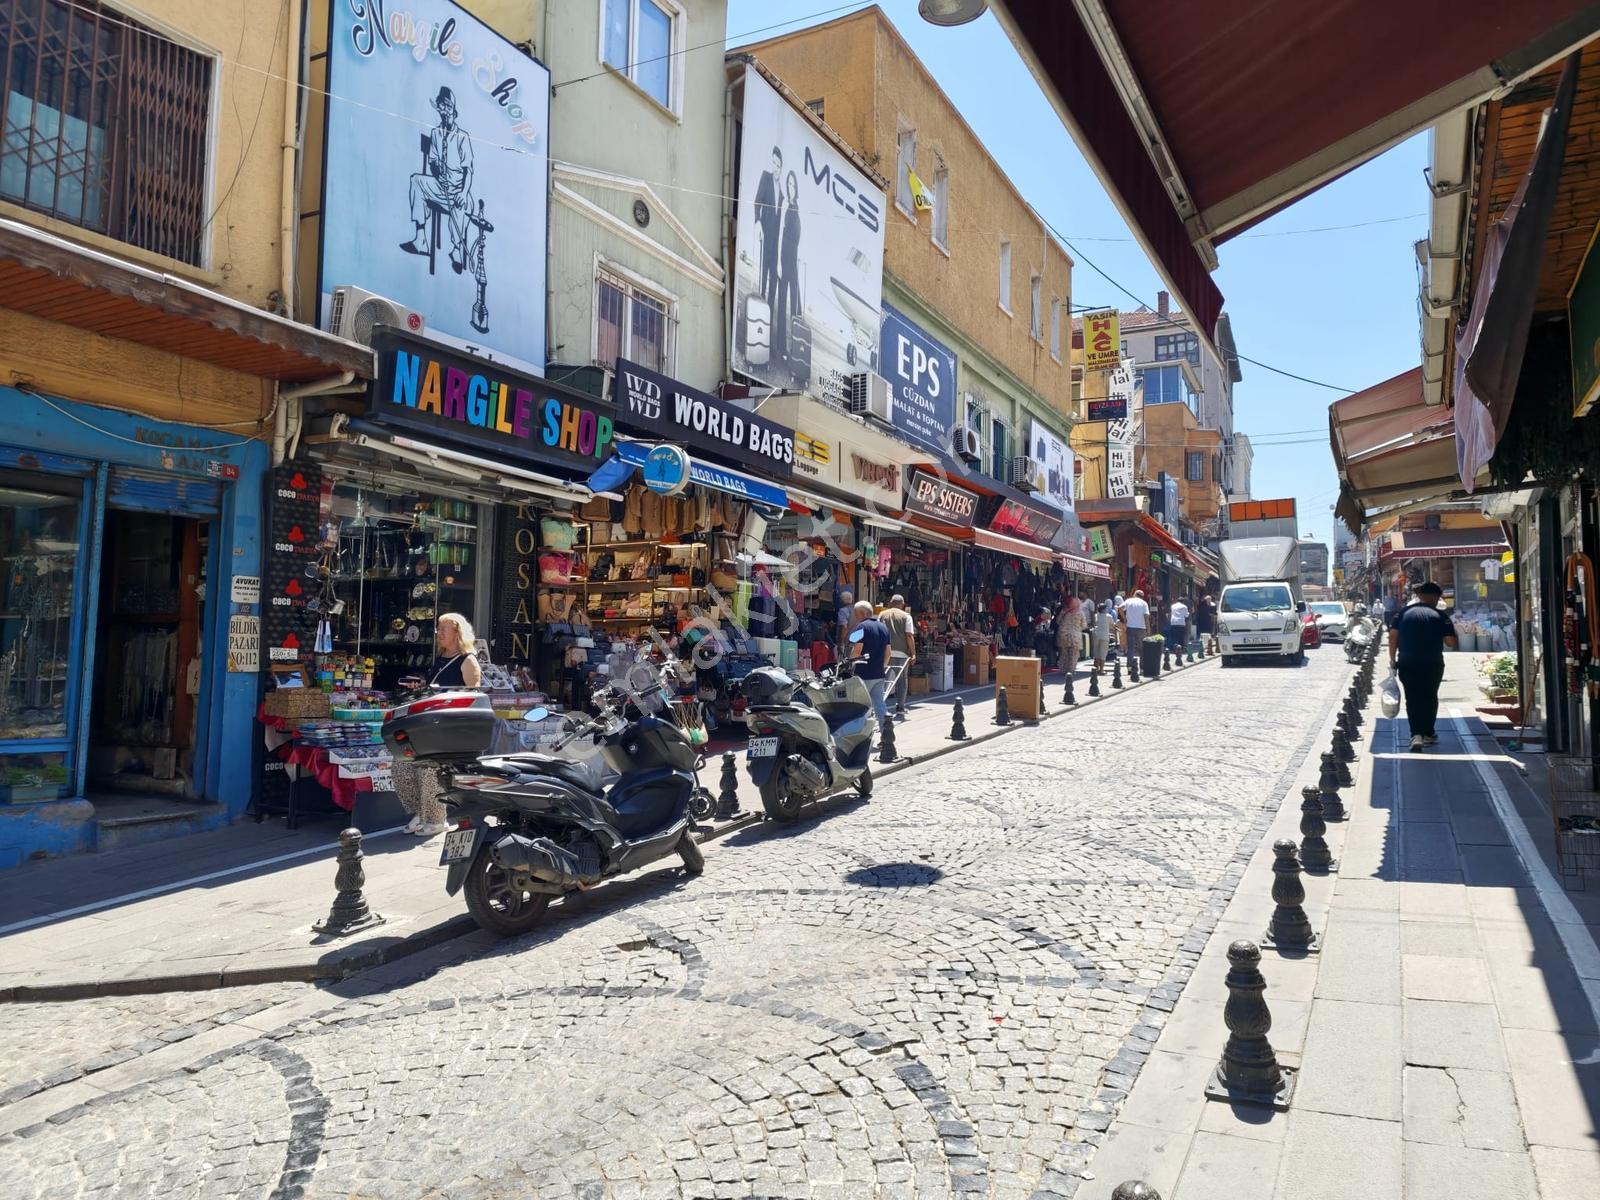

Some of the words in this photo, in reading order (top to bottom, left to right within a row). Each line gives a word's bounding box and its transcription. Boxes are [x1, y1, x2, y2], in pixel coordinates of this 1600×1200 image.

[351, 0, 464, 65] Nargile
[472, 50, 536, 144] Shop
[897, 333, 940, 398] EPS
[628, 389, 647, 402] WORLD
[647, 396, 661, 407] BAGS
[902, 386, 935, 415] CÜZDAN
[893, 397, 916, 416] MALAT
[922, 413, 945, 433] TOPTAN
[543, 398, 613, 459] SHOP
[674, 392, 744, 446] WORLD
[749, 423, 794, 465] BAGS
[1112, 452, 1123, 460] Hi
[1112, 460, 1125, 468] lal
[690, 466, 723, 486] WORLD
[723, 475, 748, 494] BAGS
[1110, 475, 1124, 488] Hi
[278, 489, 297, 499] COCO
[916, 480, 938, 504] EPS
[938, 489, 974, 517] SISTERS
[1112, 485, 1129, 498] lal
[275, 543, 294, 552] COCO
[235, 578, 260, 586] AVUKAT
[272, 597, 292, 606] COCO
[230, 617, 258, 635] BİLDİK
[229, 636, 260, 650] PAZARI
[264, 763, 284, 771] COCO
